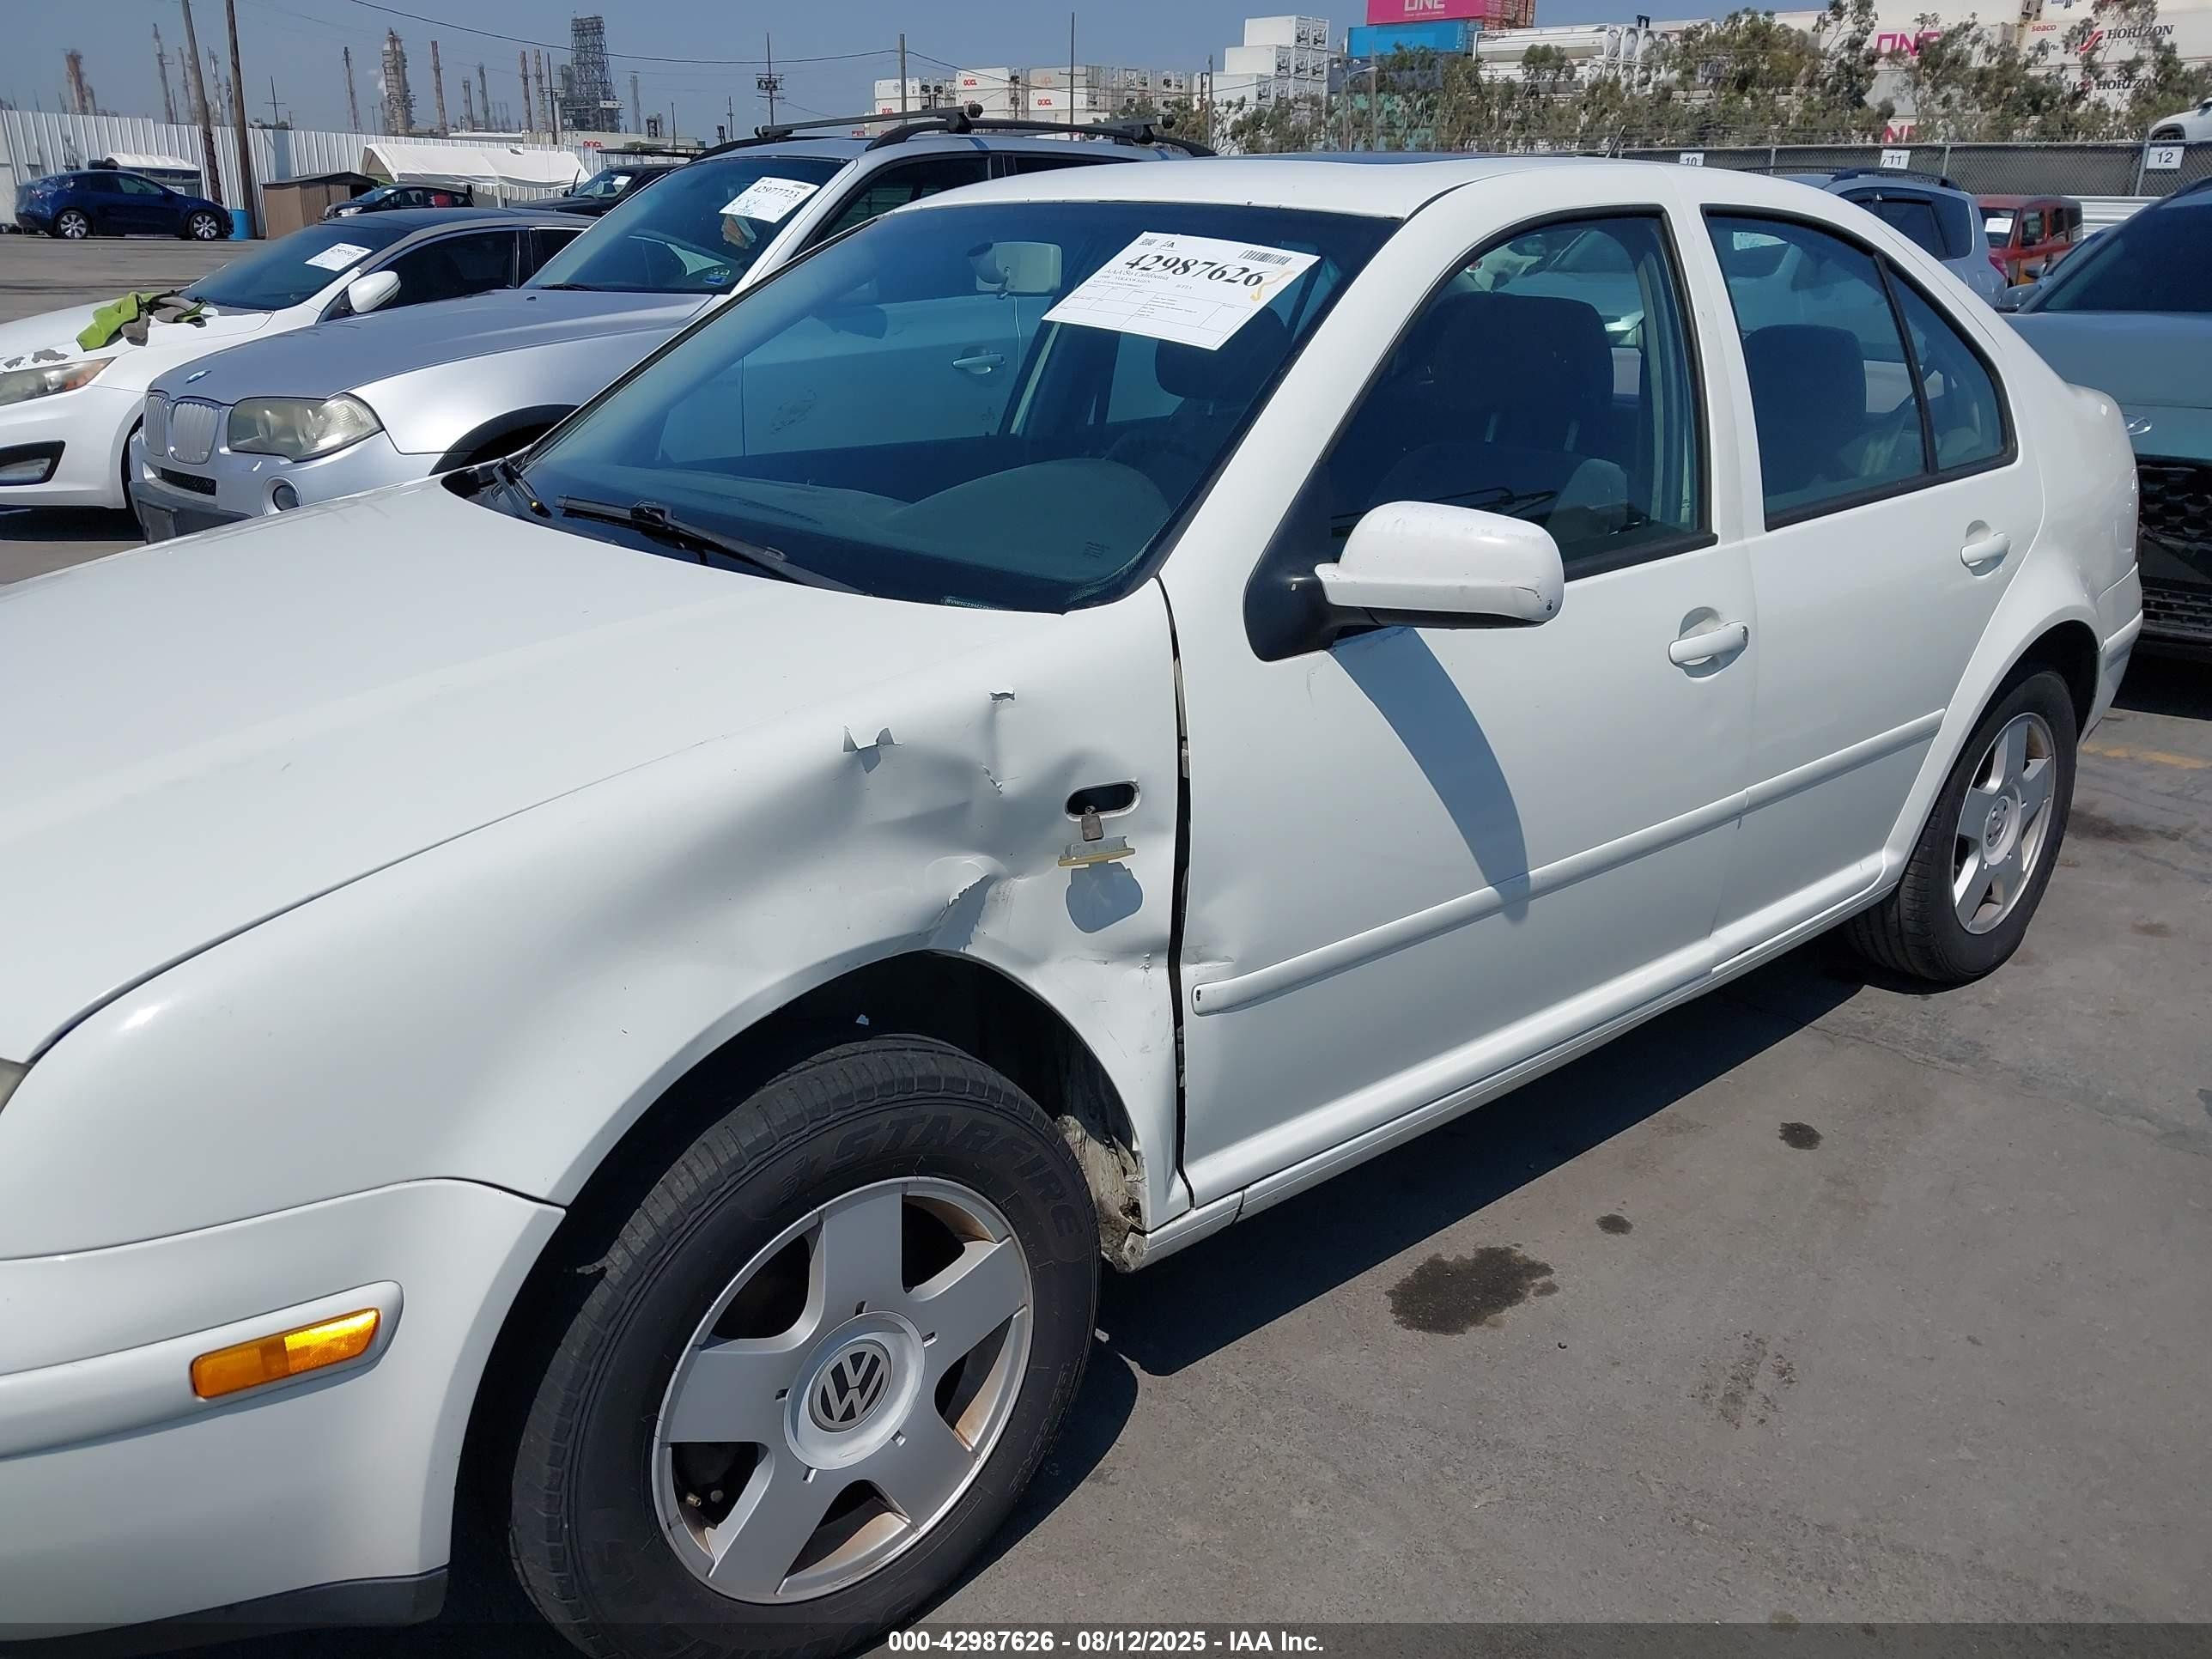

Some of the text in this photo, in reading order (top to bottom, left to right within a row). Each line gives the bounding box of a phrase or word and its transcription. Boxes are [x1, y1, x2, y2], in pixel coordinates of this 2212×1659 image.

[1404, 0, 1445, 11] ONE
[2031, 24, 2057, 33] seaco
[2106, 24, 2175, 40] HORIZON
[1875, 32, 1942, 57] ON
[1889, 154, 1903, 166] 11
[2157, 151, 2174, 164] 12
[752, 185, 800, 199] 42977723
[1124, 253, 1264, 287] 42987626
[1133, 270, 1170, 282] California
